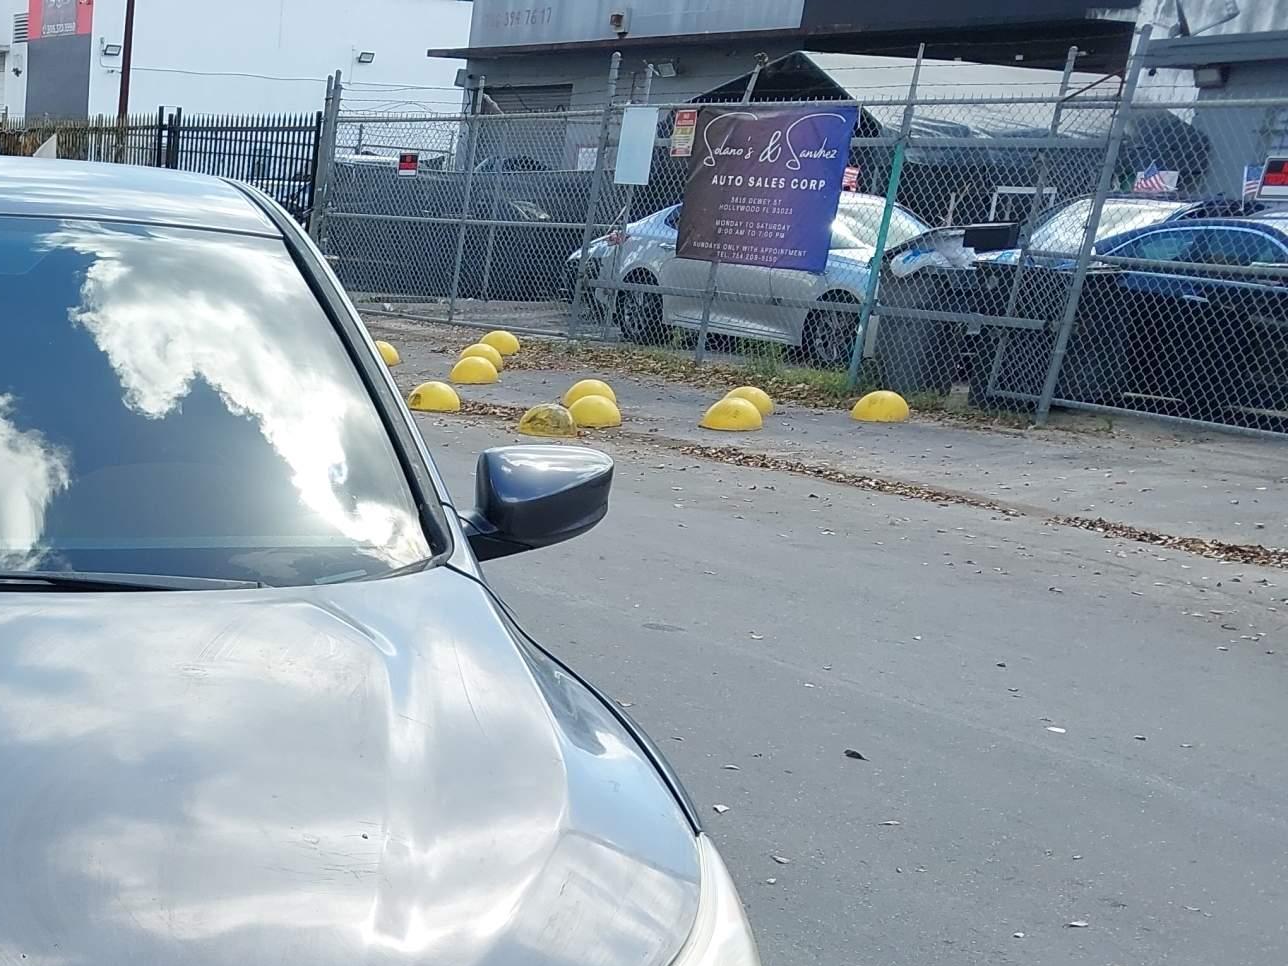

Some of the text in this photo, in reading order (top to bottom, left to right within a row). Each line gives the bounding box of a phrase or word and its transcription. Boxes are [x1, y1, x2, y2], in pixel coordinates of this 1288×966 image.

[759, 130, 782, 163] &
[711, 174, 826, 191] AUTO SALES CORP
[748, 197, 771, 205] DEWEY
[718, 203, 760, 213] HOLLYWOOD
[715, 219, 743, 227] MONDAY
[735, 228, 745, 236] AM
[747, 229, 756, 237] TO
[775, 231, 785, 239] PM
[692, 241, 807, 257] SUNDAYS ONLY WITH APPOINTMENT
